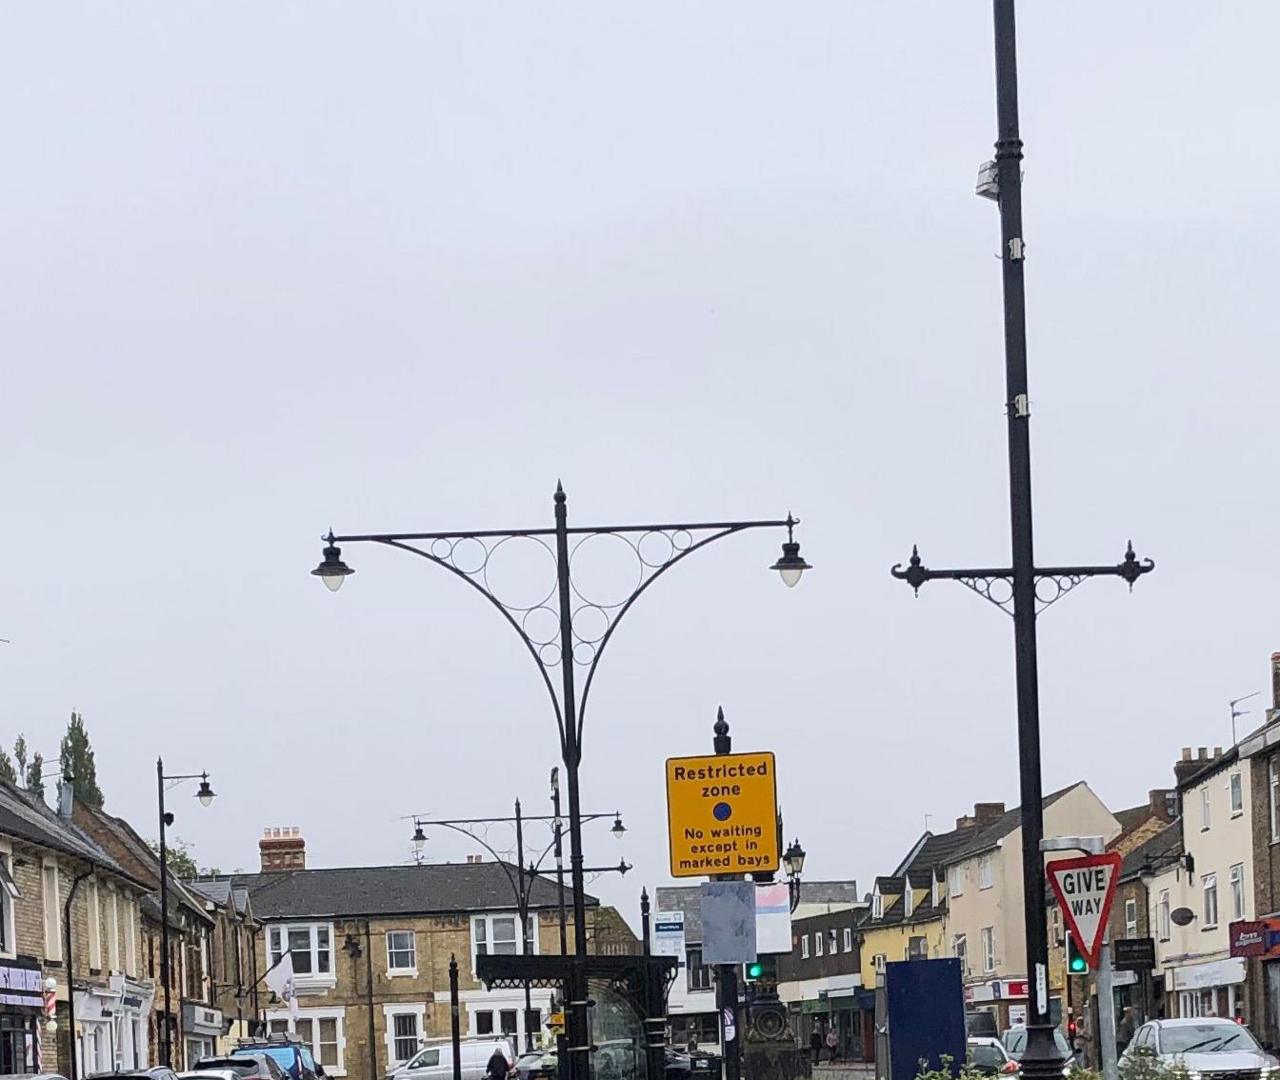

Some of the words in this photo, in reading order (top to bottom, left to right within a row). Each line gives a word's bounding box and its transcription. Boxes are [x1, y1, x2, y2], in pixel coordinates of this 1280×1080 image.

[674, 762, 767, 780] Restricted
[702, 785, 741, 797] zone
[685, 828, 703, 839] No
[711, 825, 762, 837] waiting
[690, 841, 737, 853] except
[746, 840, 758, 850] in
[680, 856, 730, 868] marked
[738, 855, 770, 867] bays
[1063, 869, 1105, 894] GIVE
[1071, 897, 1102, 916] WAY
